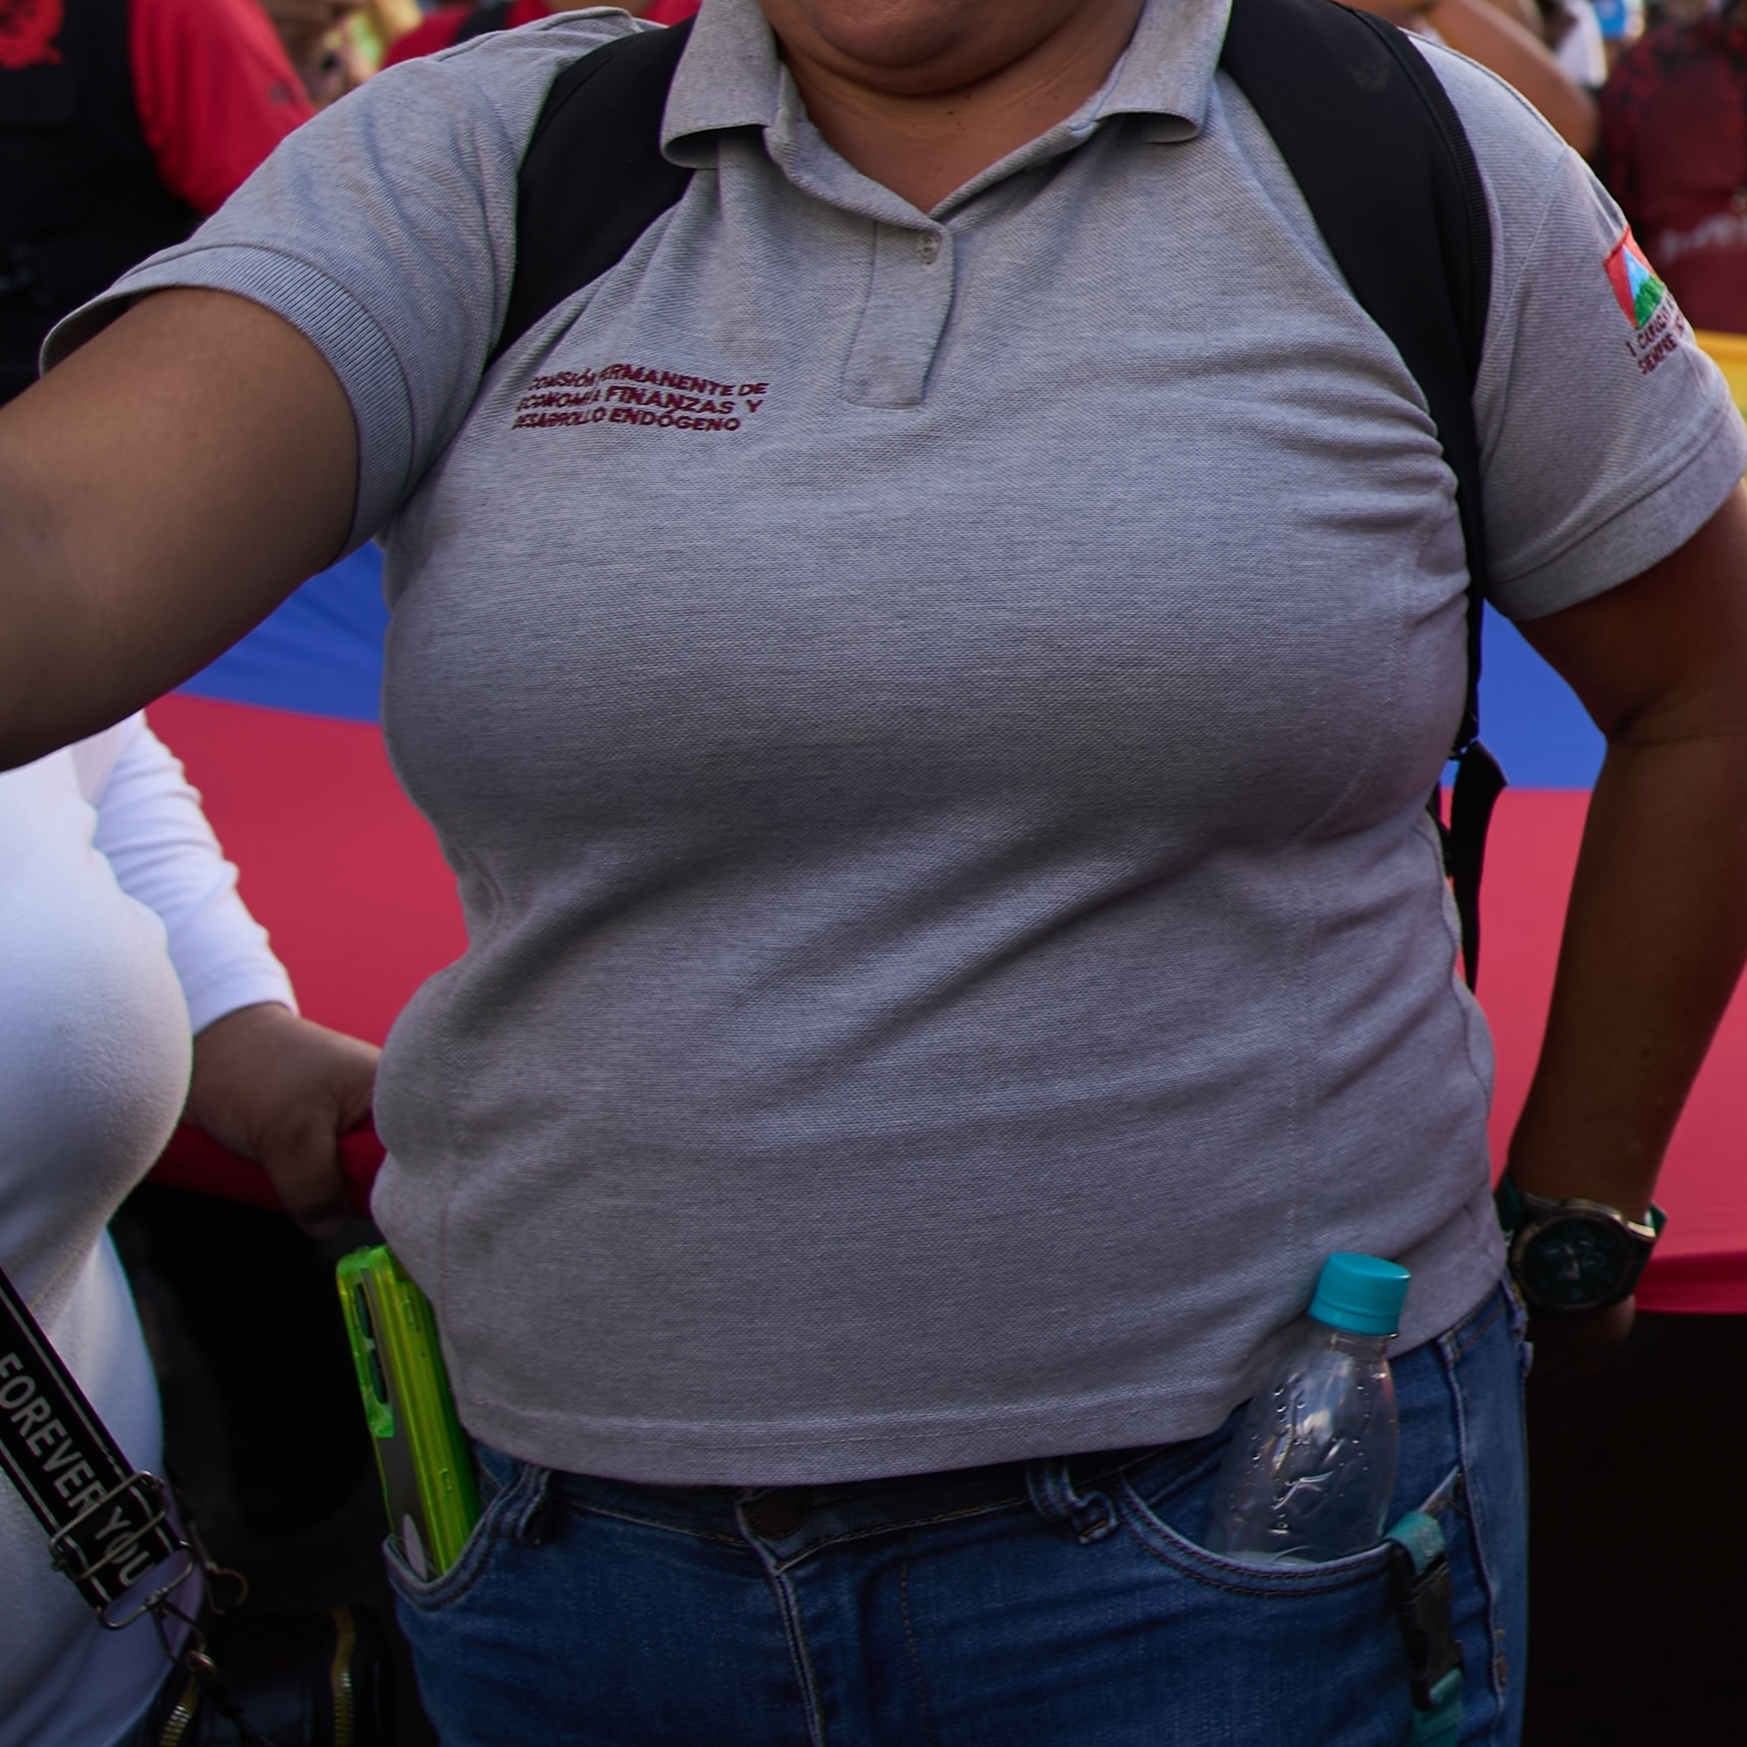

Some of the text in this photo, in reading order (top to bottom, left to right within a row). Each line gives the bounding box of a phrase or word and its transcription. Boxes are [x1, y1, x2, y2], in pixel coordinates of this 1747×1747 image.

[604, 385, 735, 415] FINANZAS
[744, 399, 763, 414] Y
[738, 382, 770, 397] DE
[609, 407, 742, 432] ENDÓGENO
[0, 1351, 108, 1518] FOREVER
